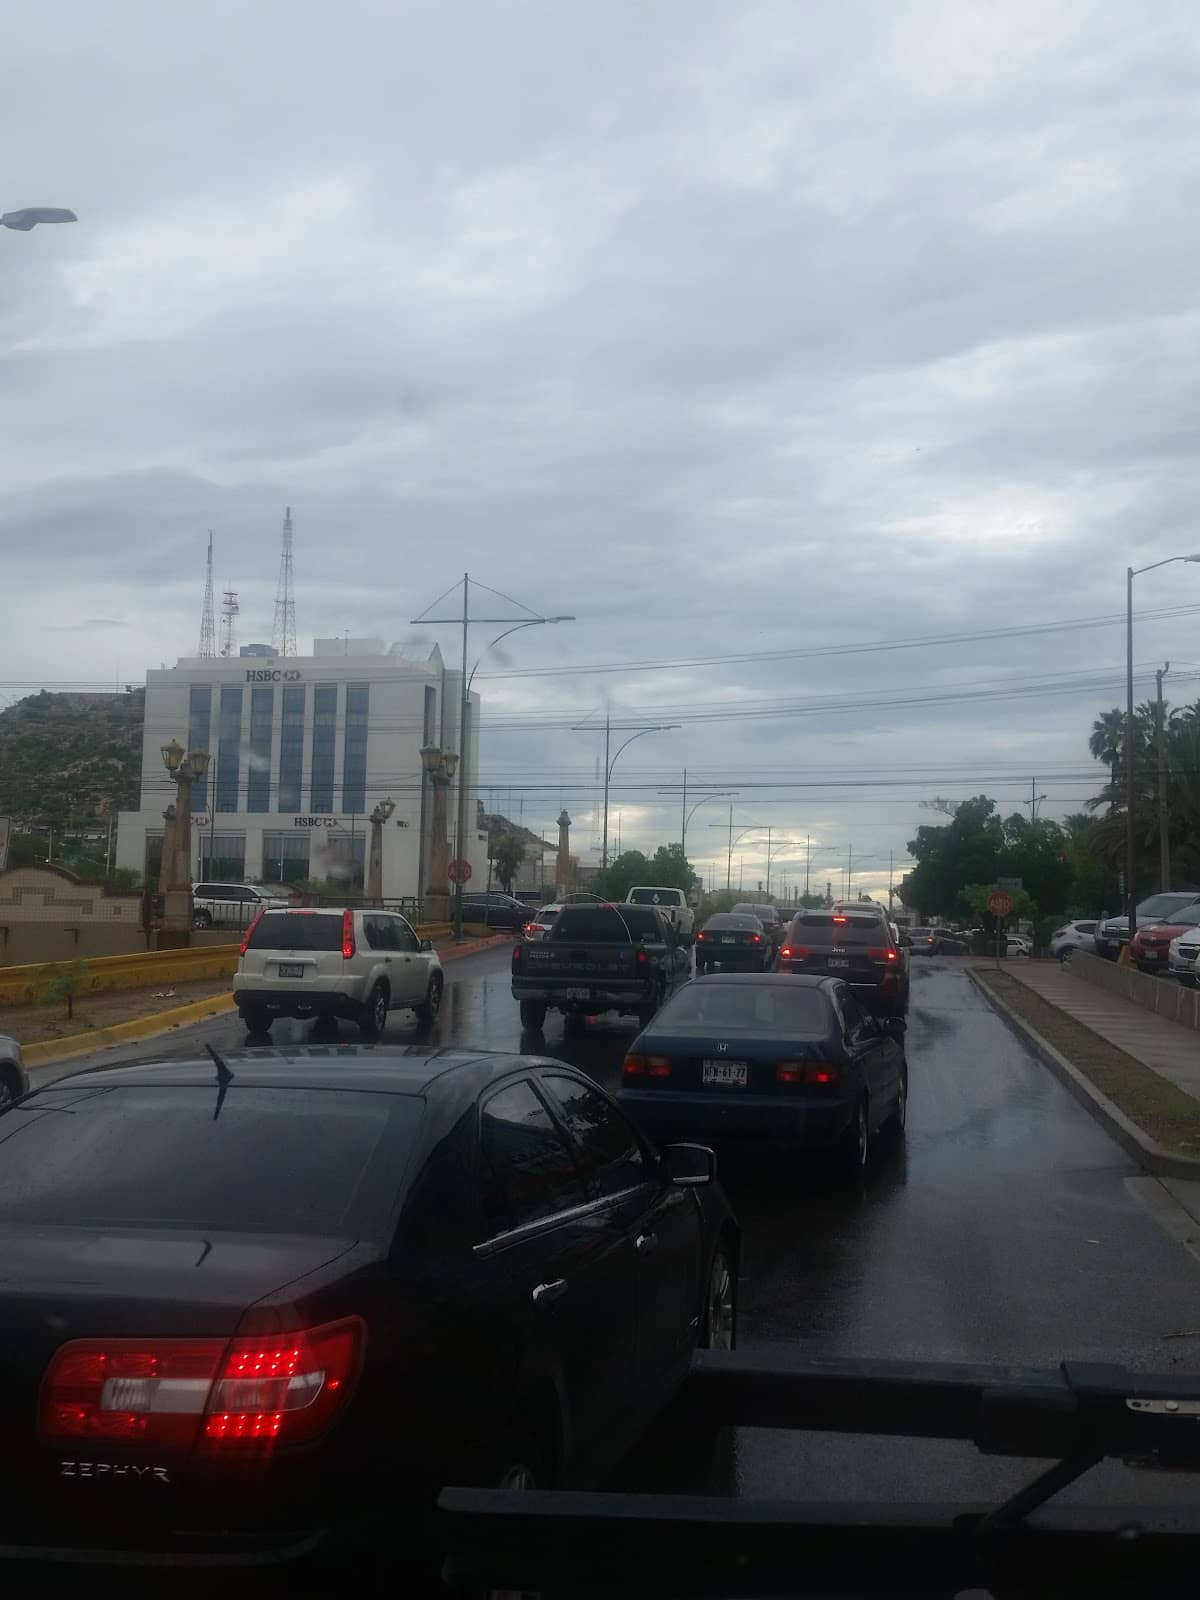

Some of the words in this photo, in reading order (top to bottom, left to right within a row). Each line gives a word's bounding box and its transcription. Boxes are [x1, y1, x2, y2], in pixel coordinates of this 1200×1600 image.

[246, 670, 281, 682] HSBC
[294, 817, 321, 827] HSBC
[61, 1461, 170, 1483] ZEPHYR
